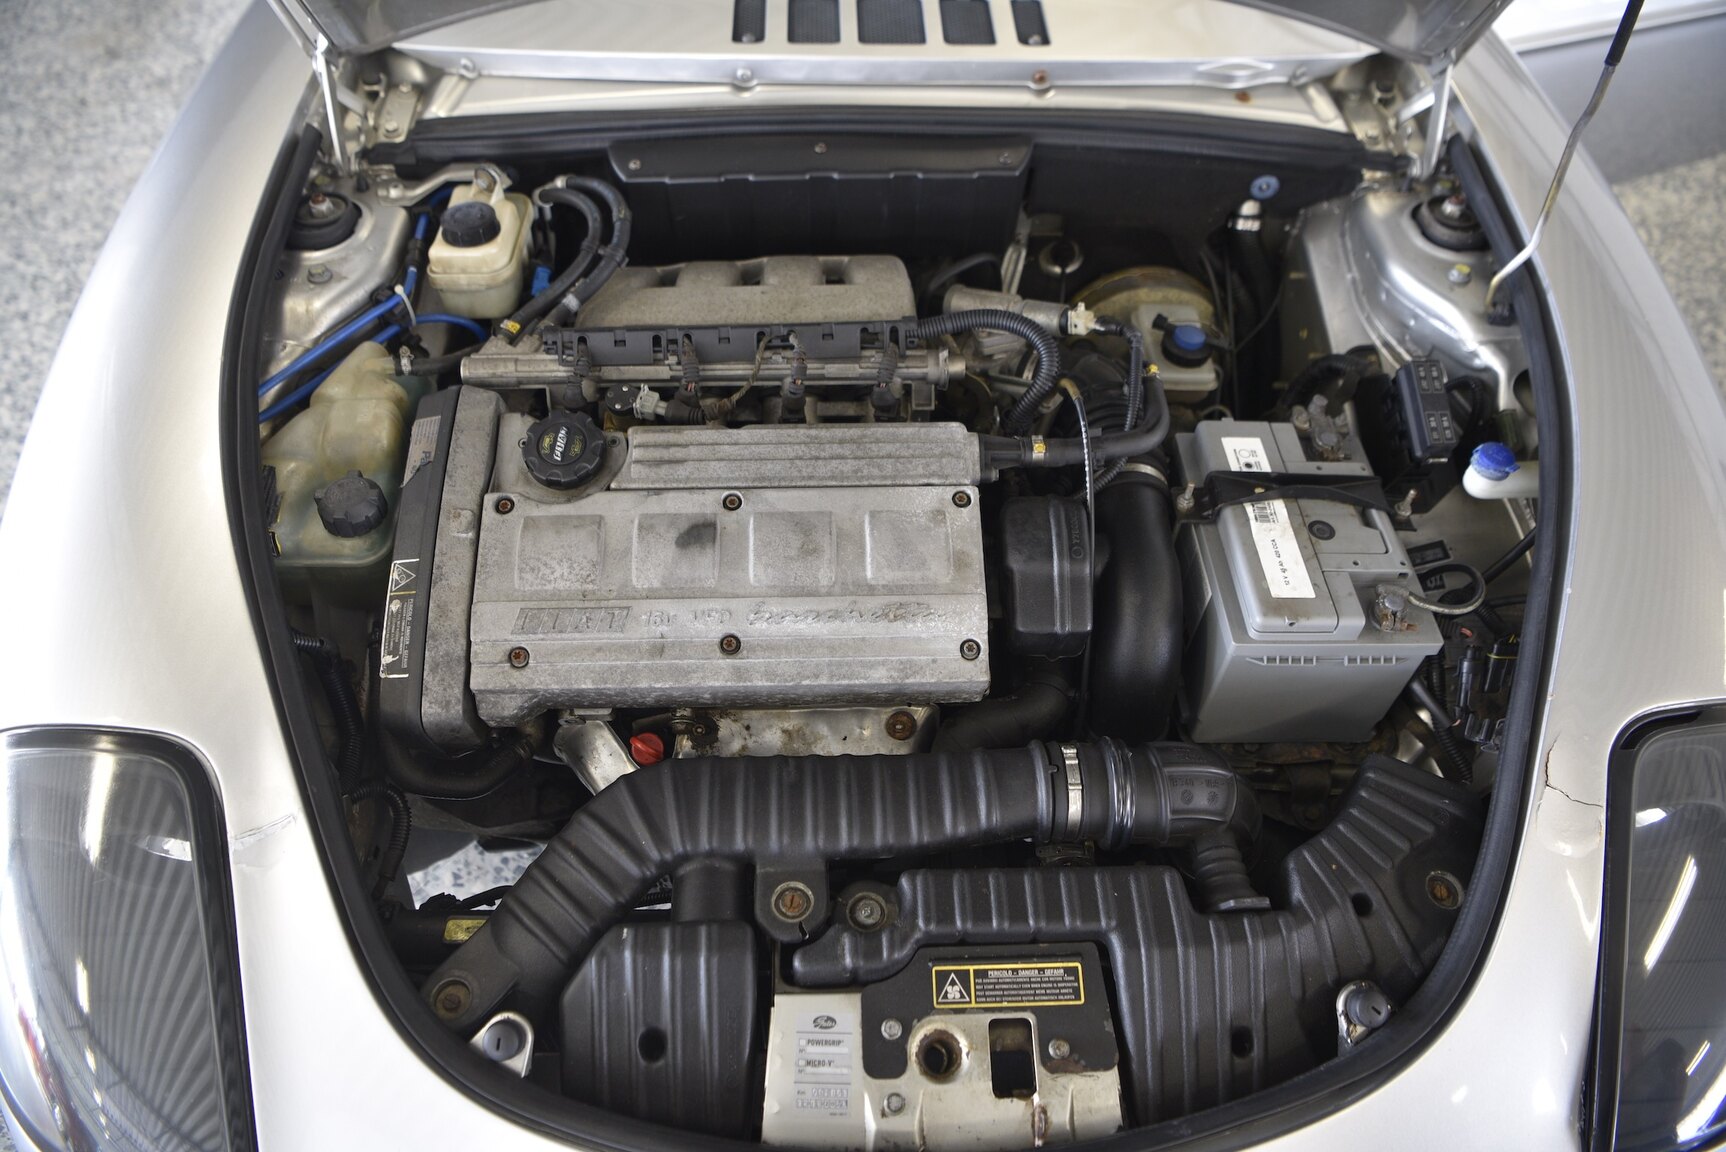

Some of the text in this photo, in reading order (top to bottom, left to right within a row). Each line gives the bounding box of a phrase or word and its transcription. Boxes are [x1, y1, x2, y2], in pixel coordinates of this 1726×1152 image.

[553, 426, 568, 461] FIAT
[1270, 538, 1278, 550] CCA
[988, 969, 1013, 977] PERICOLO
[1018, 969, 1038, 977] DANGER
[1044, 968, 1064, 976] GEFAHR
